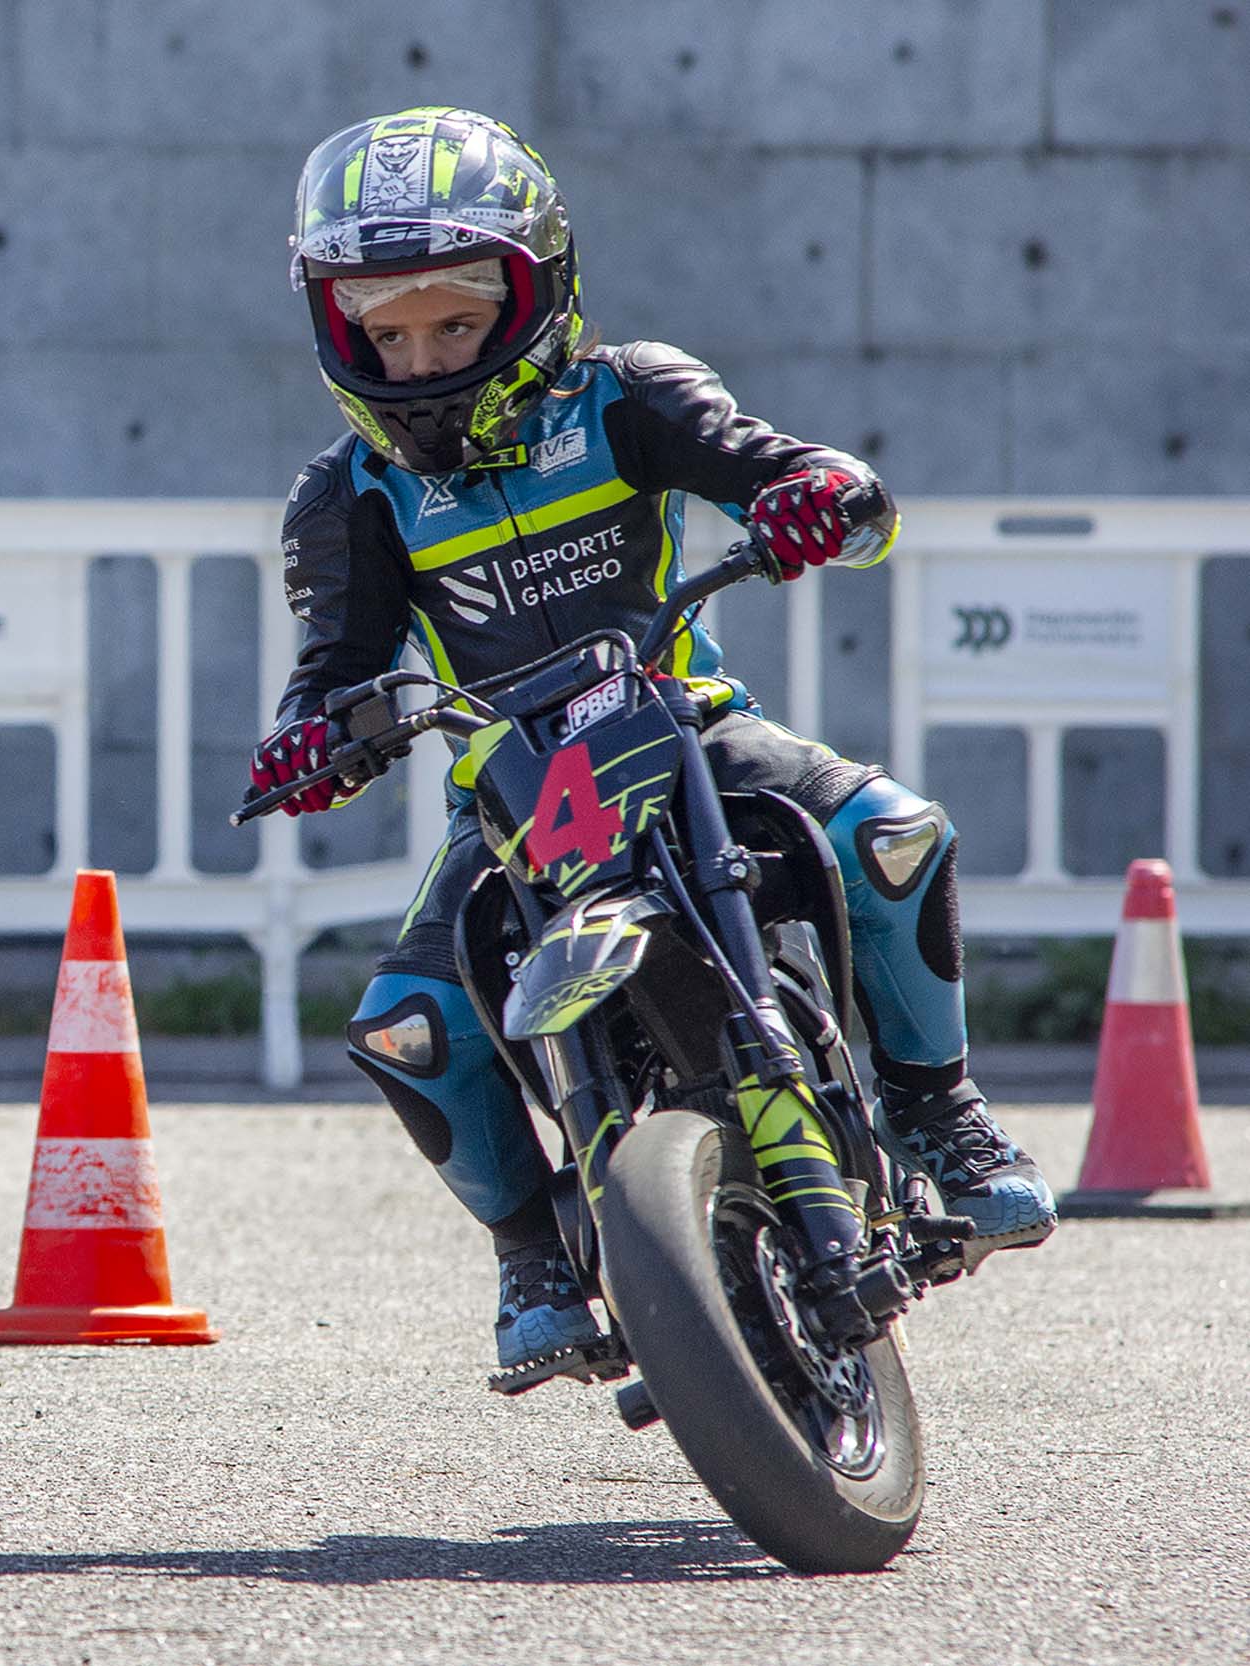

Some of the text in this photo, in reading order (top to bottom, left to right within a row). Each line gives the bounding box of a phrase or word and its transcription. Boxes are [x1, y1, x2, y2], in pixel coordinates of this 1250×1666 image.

[510, 525, 626, 580] DEPORTE
[520, 558, 623, 607] GALEGO
[525, 741, 625, 874] 4
